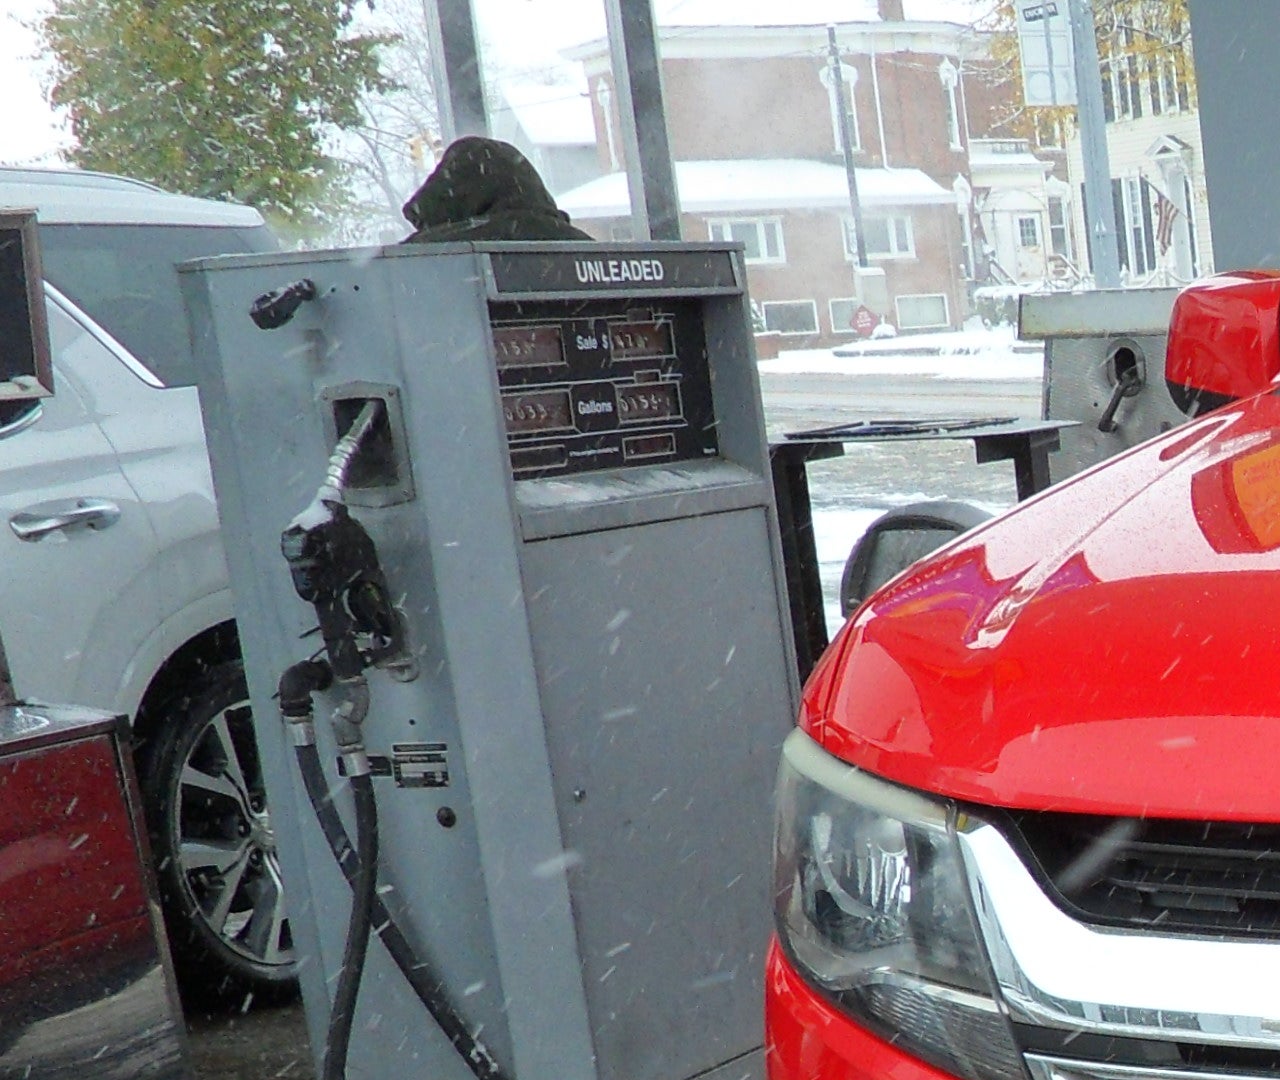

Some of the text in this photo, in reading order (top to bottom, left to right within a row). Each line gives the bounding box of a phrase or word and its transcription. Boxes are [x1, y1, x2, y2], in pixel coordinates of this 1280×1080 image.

[574, 259, 664, 283] UNLEADED
[576, 334, 598, 350] Sale
[577, 399, 613, 415] Gallons
